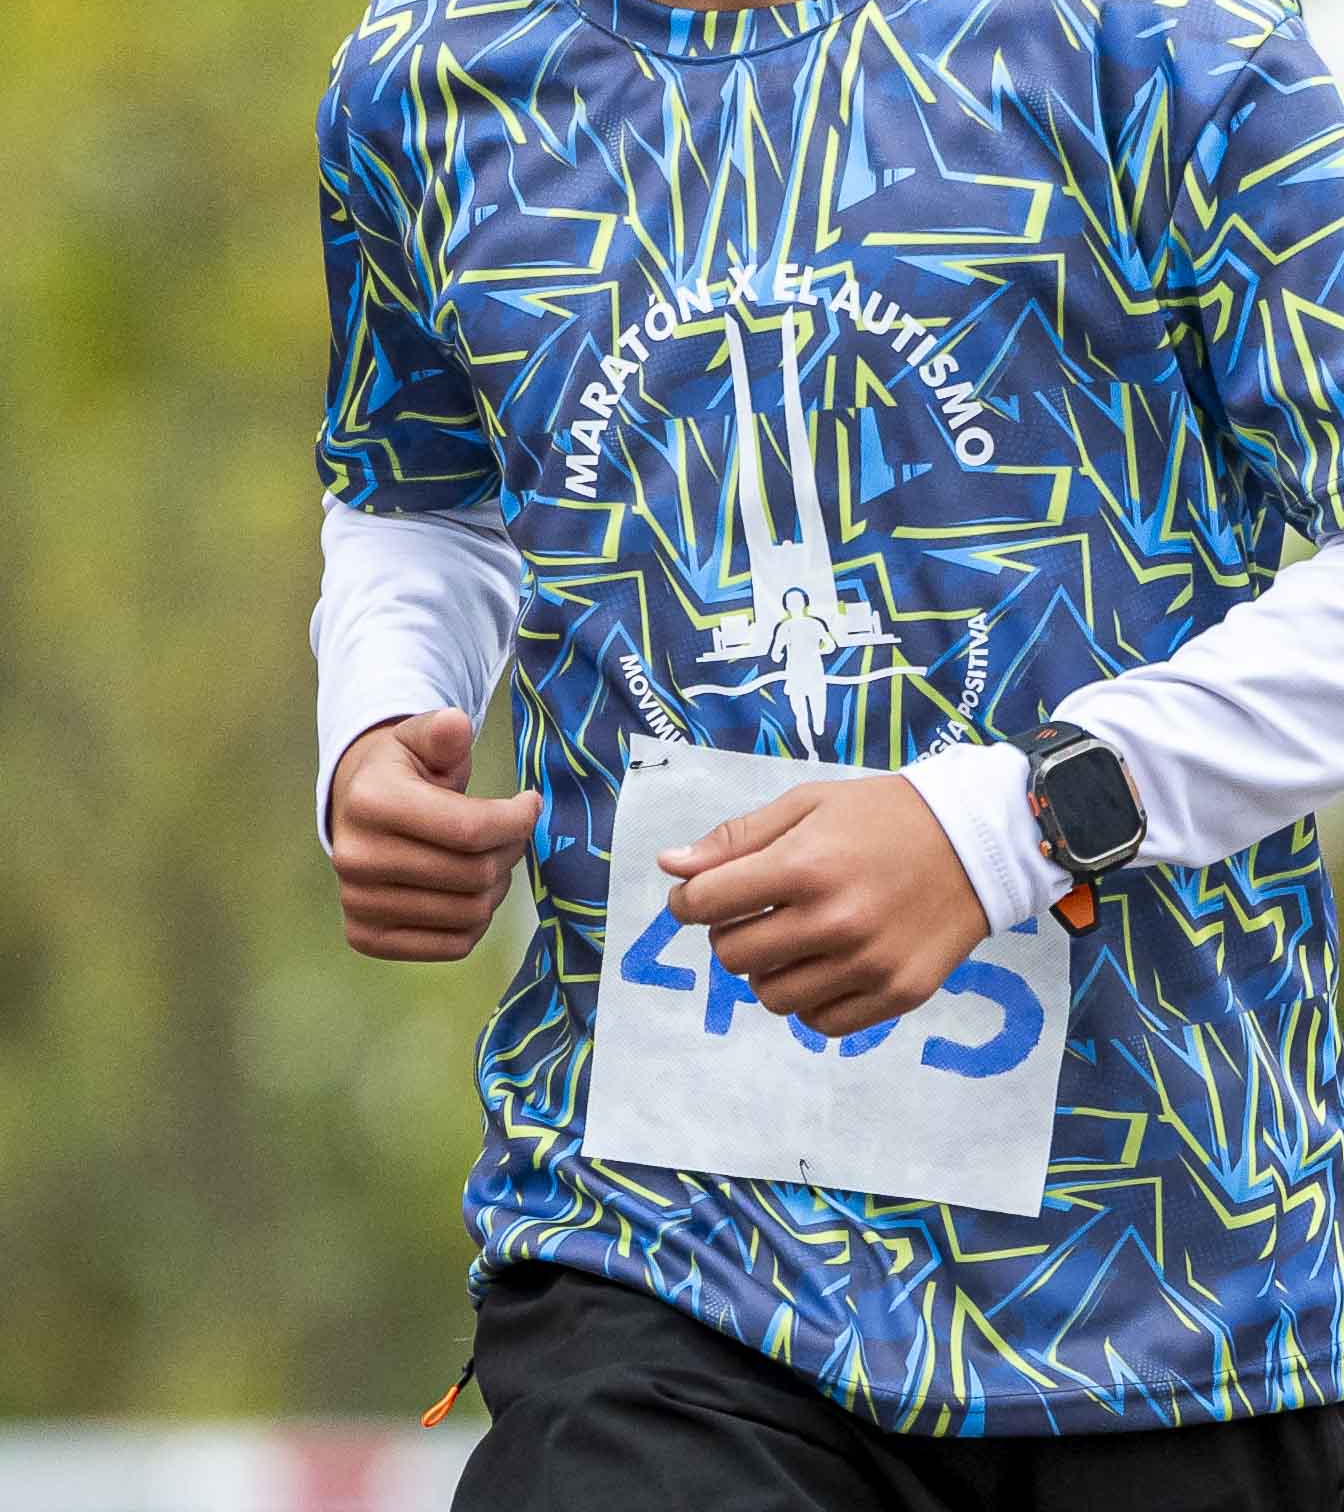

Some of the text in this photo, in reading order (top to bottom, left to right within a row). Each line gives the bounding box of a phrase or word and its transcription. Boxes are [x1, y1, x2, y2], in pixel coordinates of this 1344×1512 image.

[565, 263, 994, 498] MARATÓN X EL AUTISMO
[957, 612, 990, 720] POSITIVA
